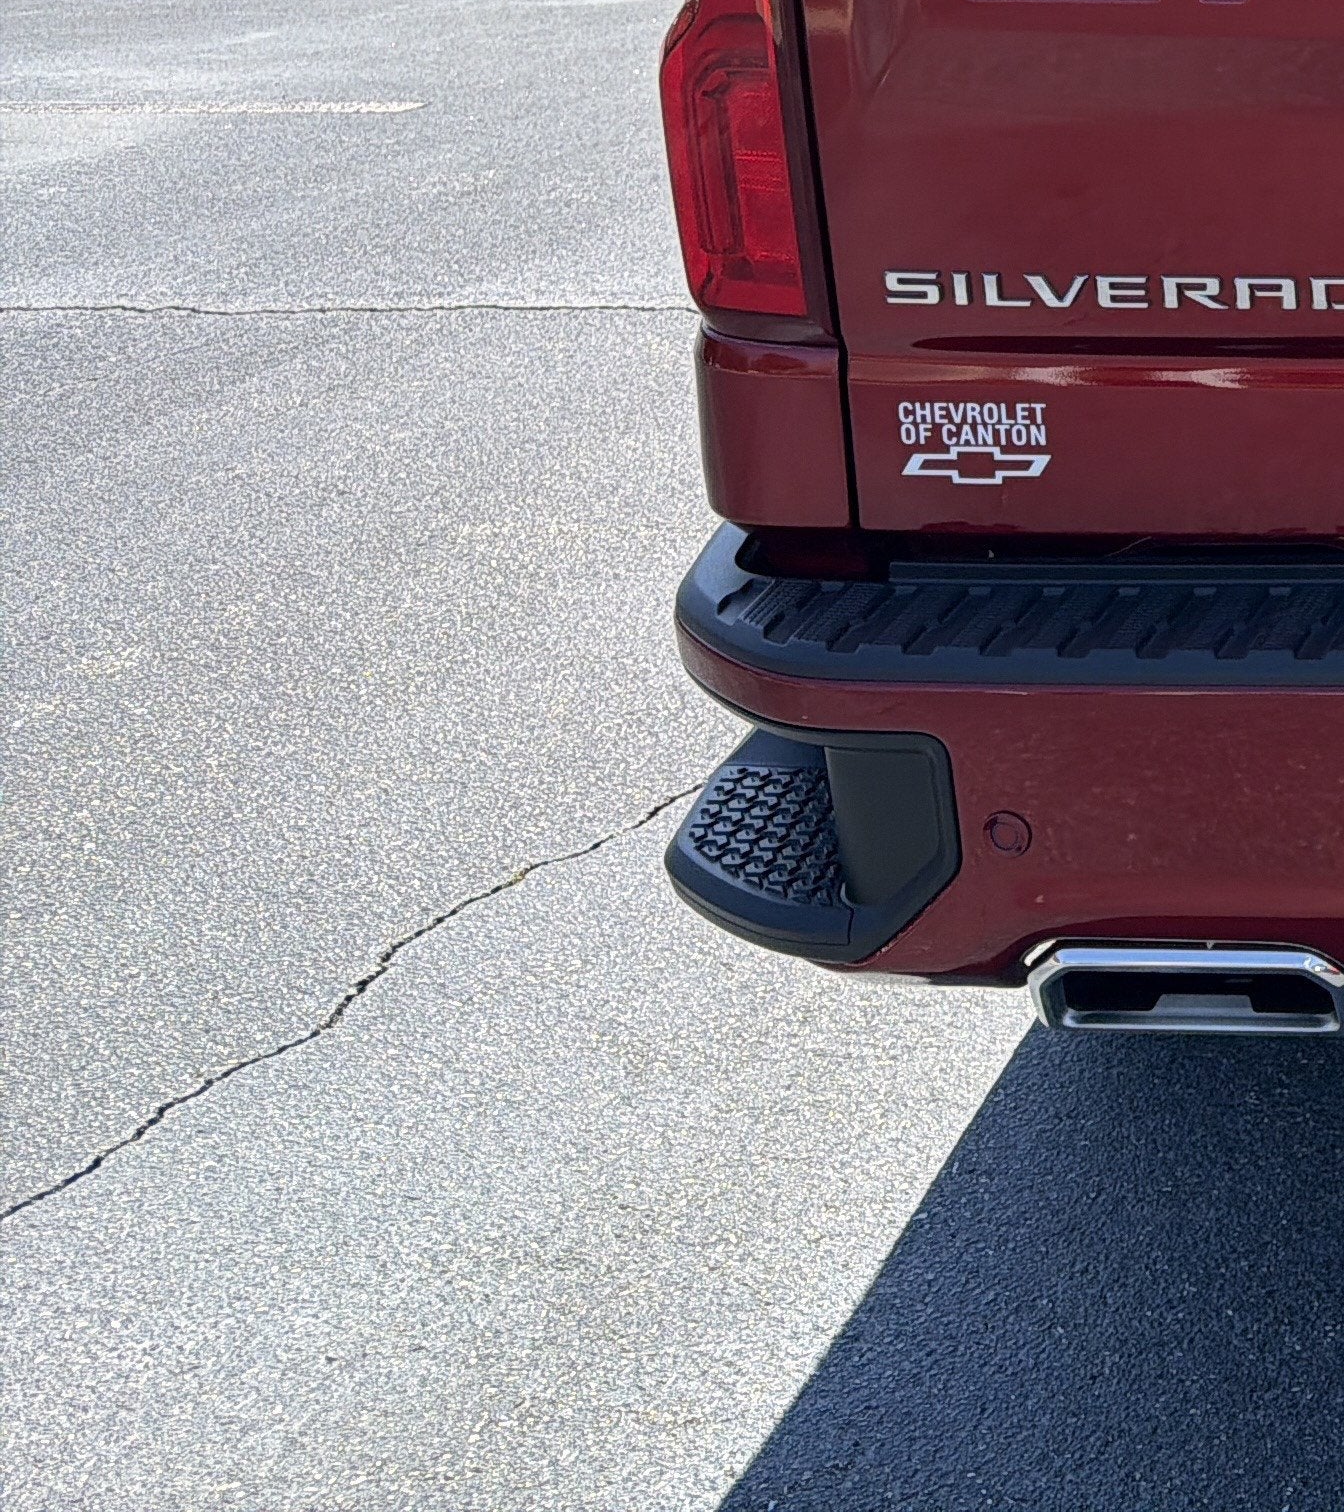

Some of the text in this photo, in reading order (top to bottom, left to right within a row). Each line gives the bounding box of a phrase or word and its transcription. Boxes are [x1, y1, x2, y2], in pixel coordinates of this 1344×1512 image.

[898, 401, 1047, 425] CHEVROLET
[900, 423, 1047, 447] OF CANTON
